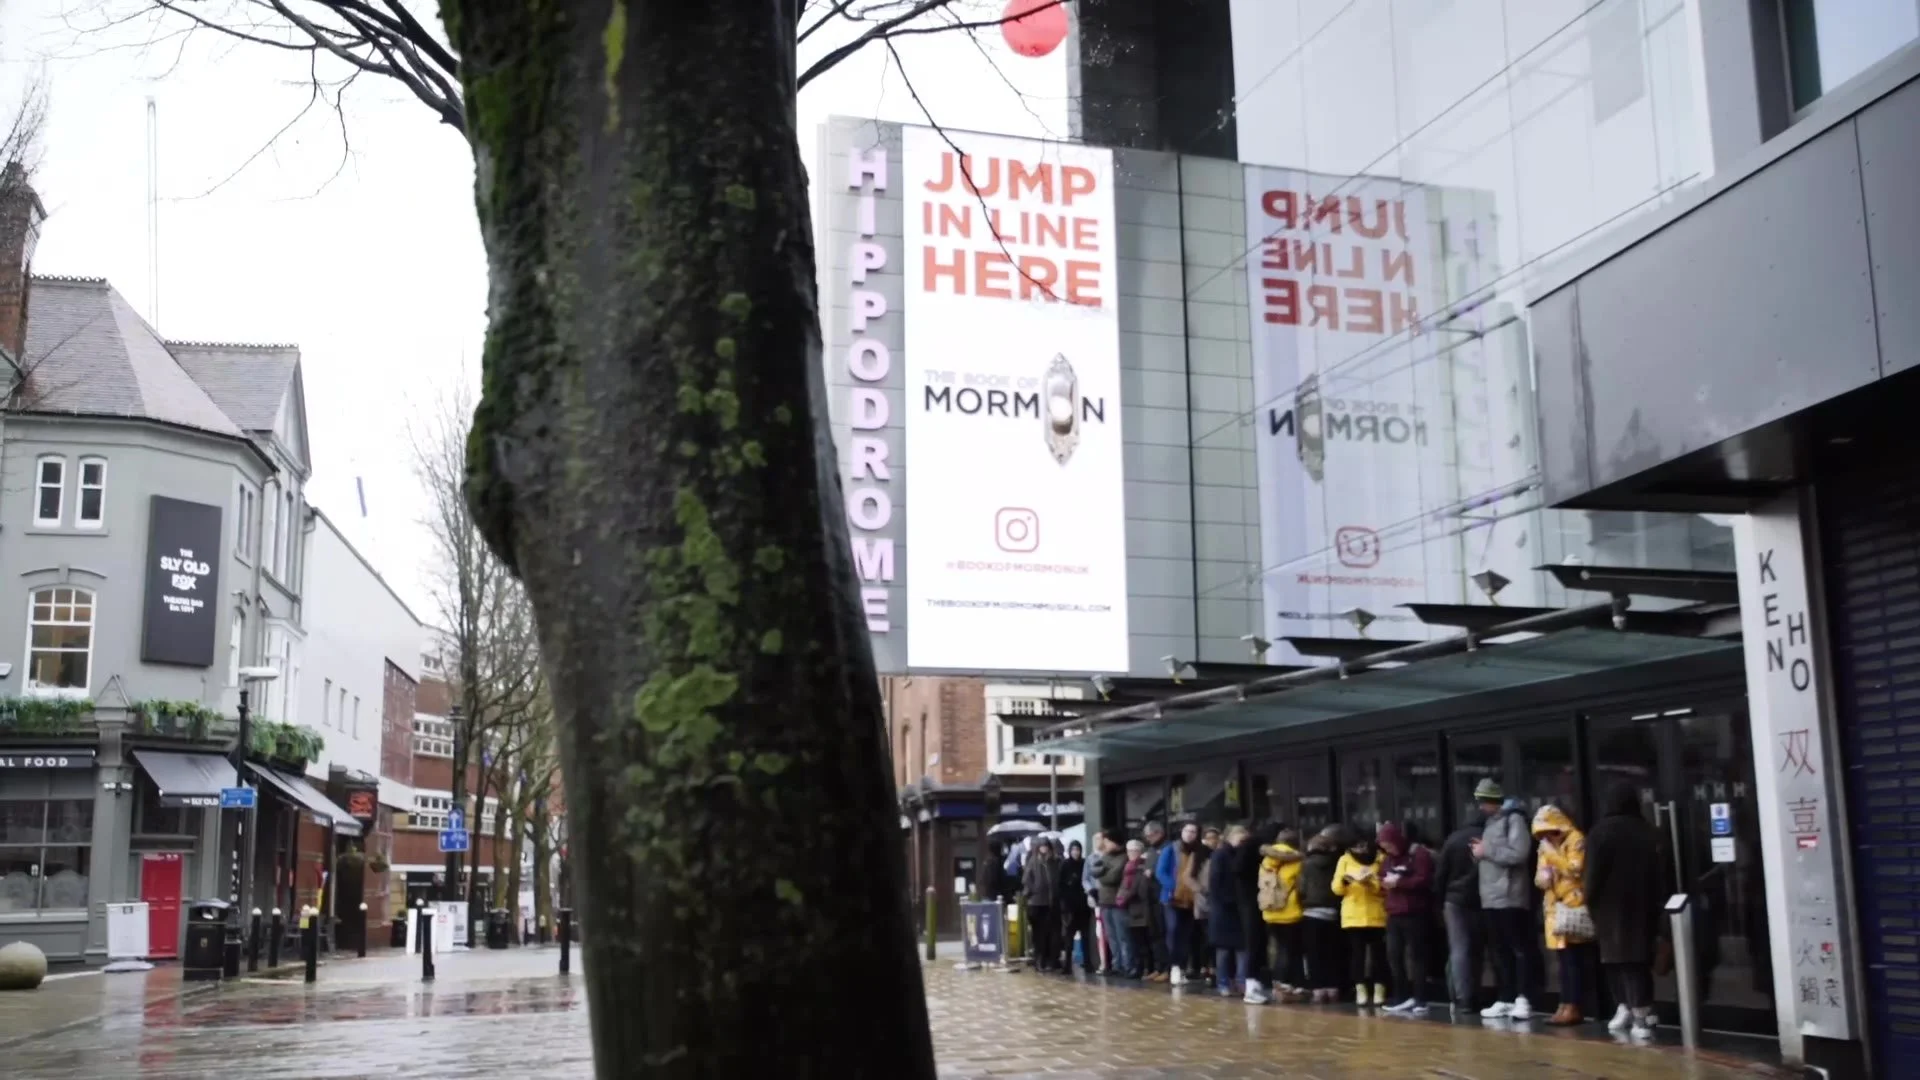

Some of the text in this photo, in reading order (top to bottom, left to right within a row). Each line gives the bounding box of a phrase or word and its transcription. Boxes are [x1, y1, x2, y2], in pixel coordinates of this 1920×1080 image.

[923, 151, 1097, 207] JUMP
[923, 201, 1100, 252] IN LINE
[923, 246, 1103, 308] HERE
[848, 146, 894, 633] HIPPODROME
[924, 369, 956, 384] THE
[964, 372, 1011, 388] BOOK
[160, 555, 210, 576] SLY OLD
[172, 573, 197, 590] FOX
[24, 756, 68, 767] FOOD
